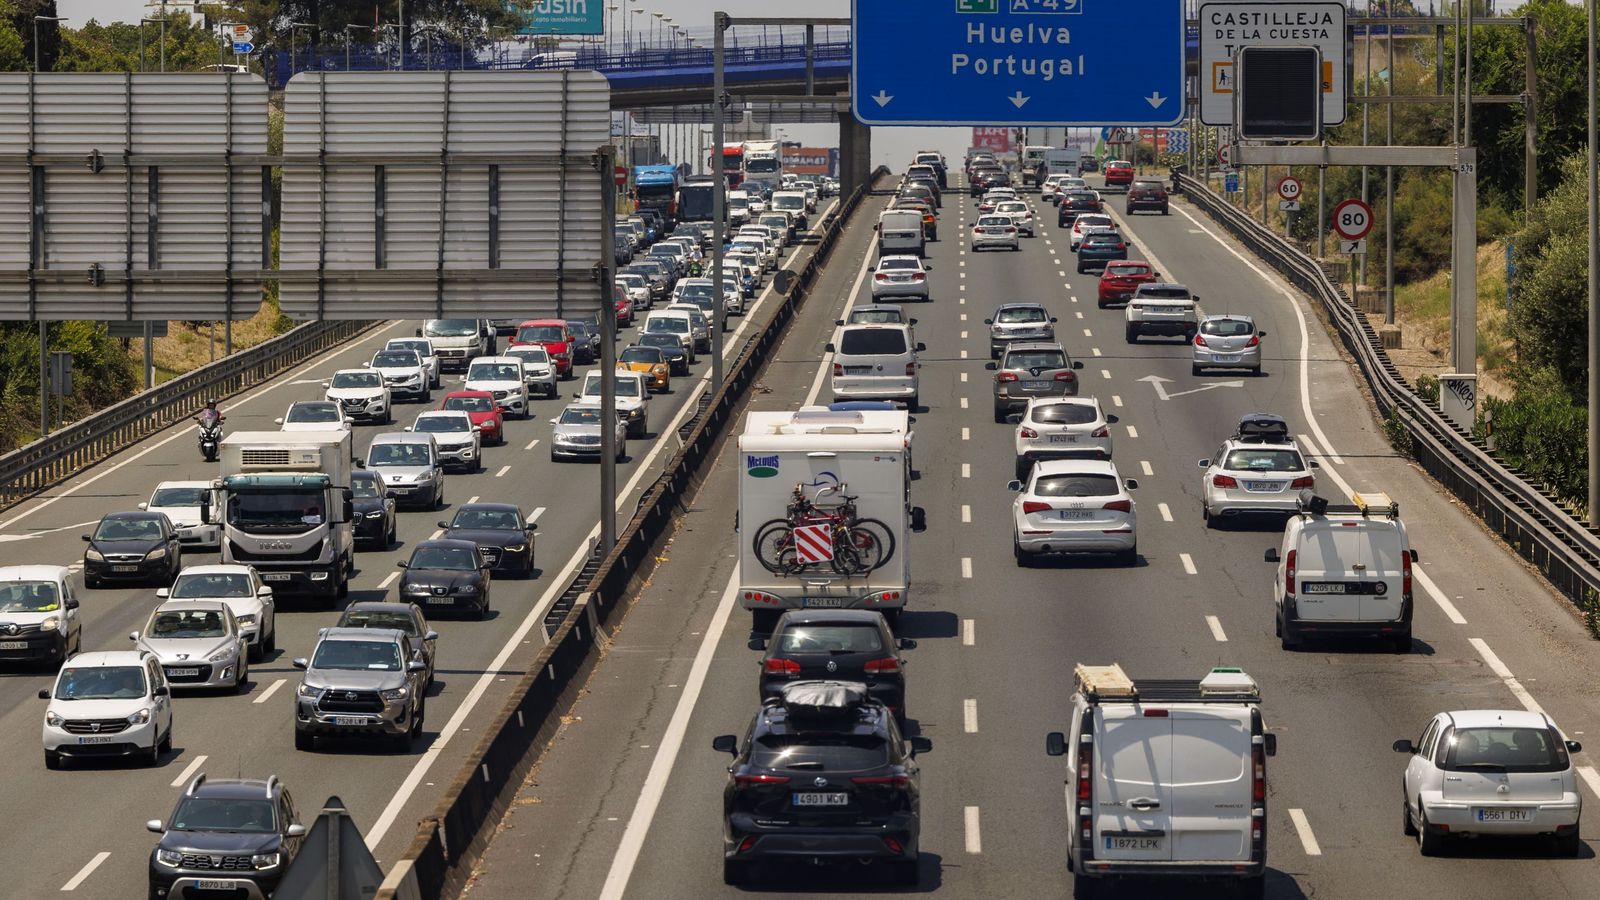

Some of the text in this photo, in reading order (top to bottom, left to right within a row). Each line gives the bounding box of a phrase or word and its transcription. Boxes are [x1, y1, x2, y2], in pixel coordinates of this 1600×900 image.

[1211, 12, 1333, 26] CASTILLEJA
[966, 22, 1071, 44] Huelva
[1215, 29, 1329, 40] DE LA CUESTA
[951, 54, 1085, 81] Portugal
[1282, 184, 1297, 193] 60
[1341, 213, 1364, 226] 80
[1311, 583, 1329, 592] 4205
[800, 794, 824, 804] 4901
[1484, 810, 1505, 820] 5561
[1114, 839, 1158, 849] 1872 LPK
